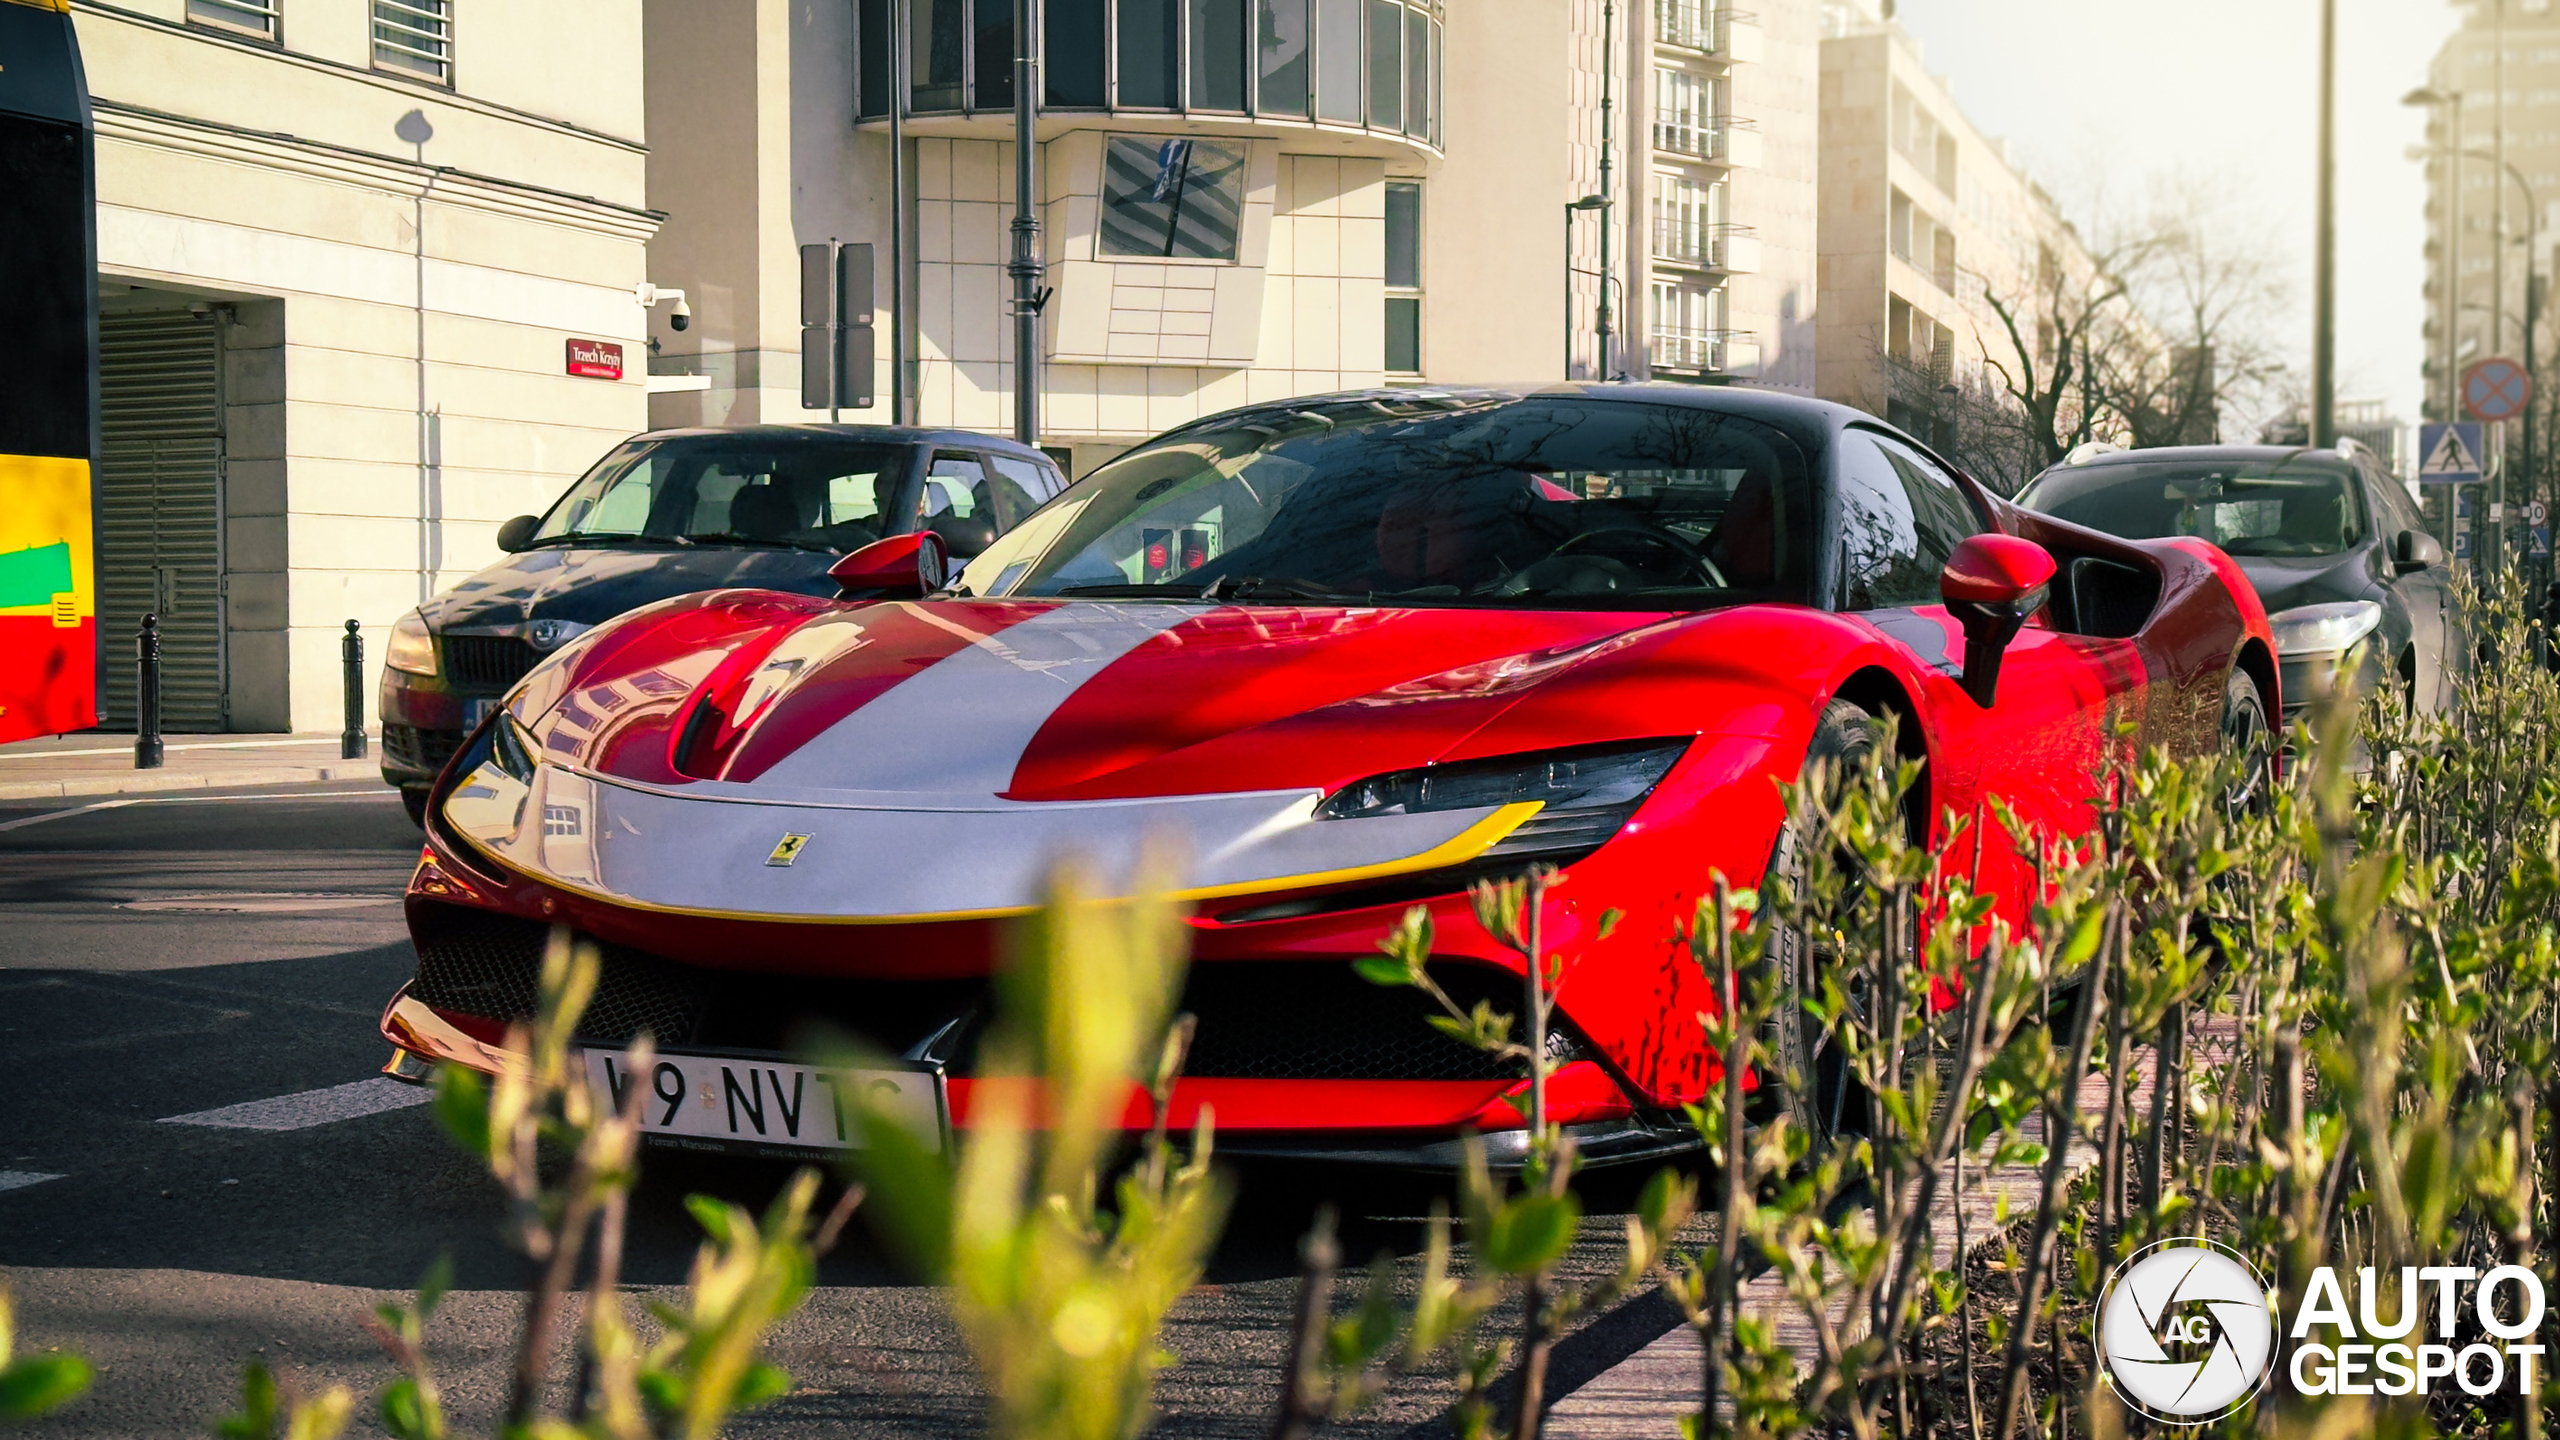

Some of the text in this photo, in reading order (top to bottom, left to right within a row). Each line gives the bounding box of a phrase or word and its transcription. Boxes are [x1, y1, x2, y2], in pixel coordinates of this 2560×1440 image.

[573, 346, 599, 363] Trzech
[600, 350, 621, 370] Krzyży
[680, 1139, 725, 1152] Warszawa
